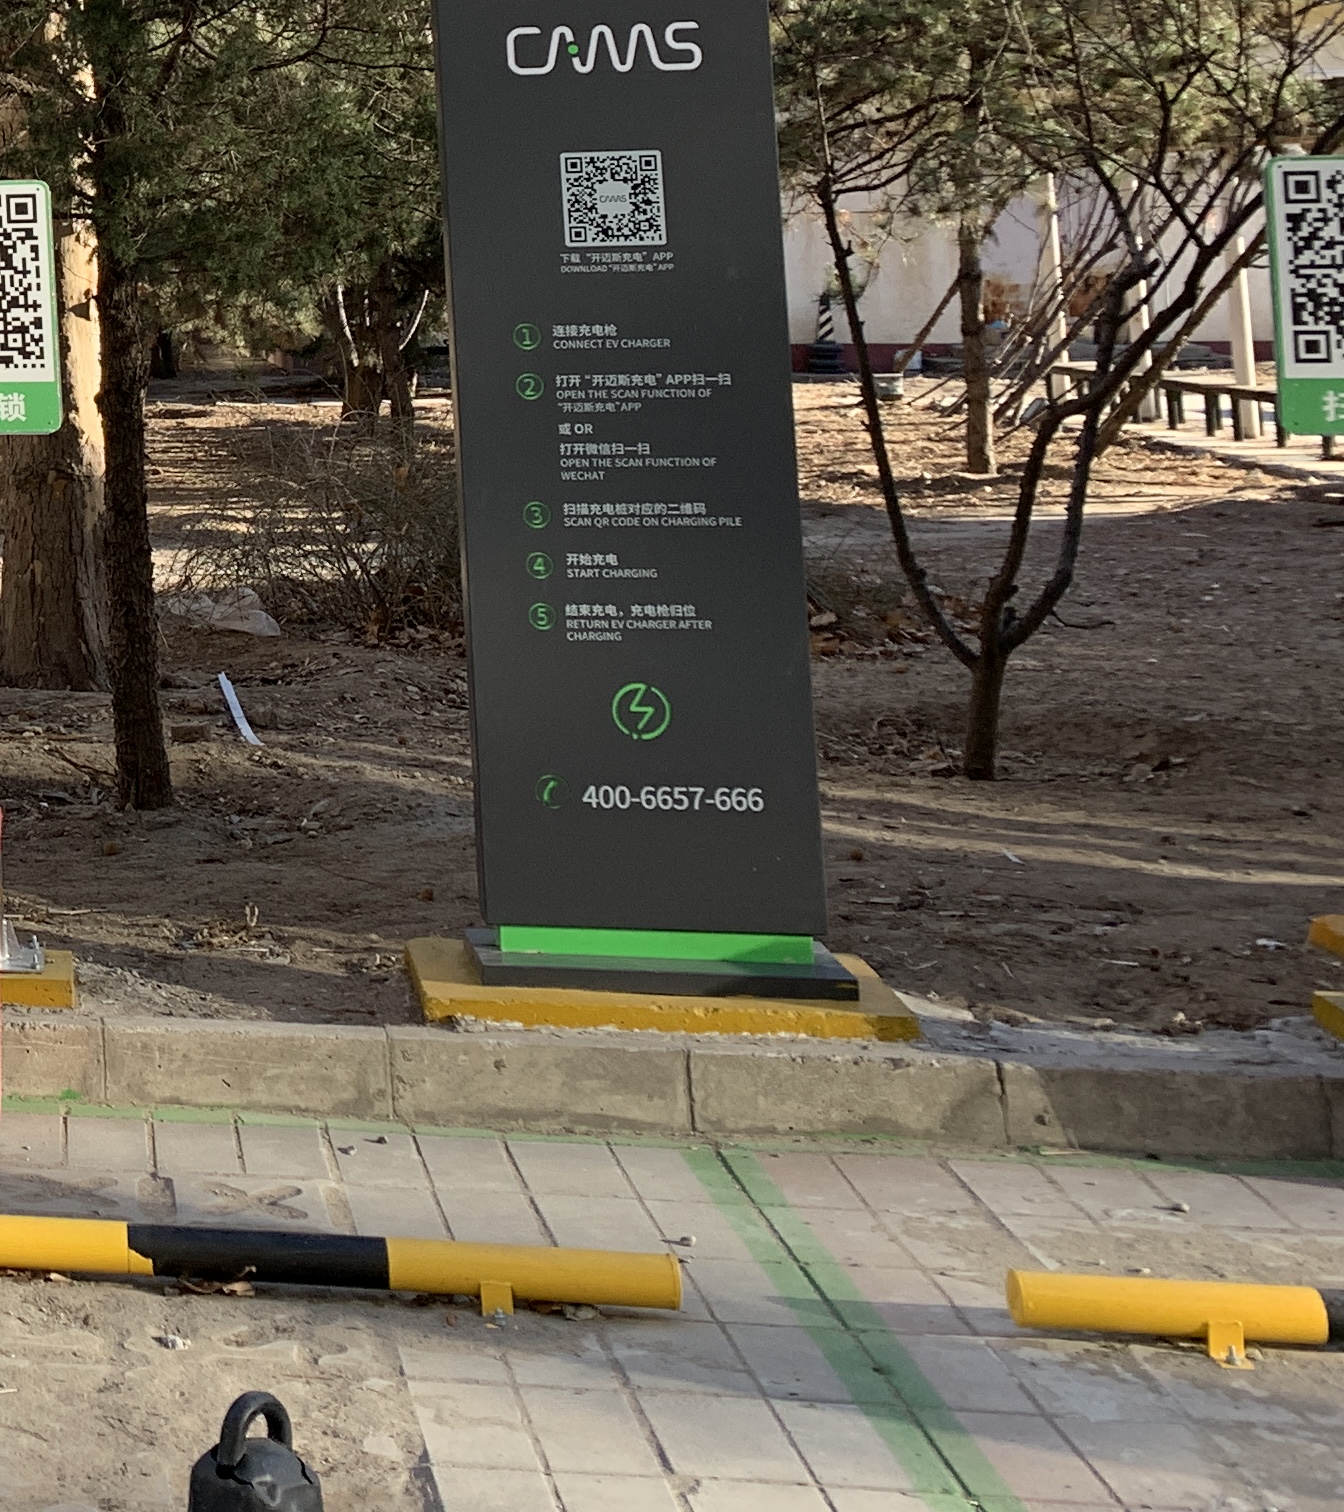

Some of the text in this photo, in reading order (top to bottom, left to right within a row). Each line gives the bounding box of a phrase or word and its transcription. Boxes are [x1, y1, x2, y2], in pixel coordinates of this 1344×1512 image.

[552, 324, 618, 338] 连接充电枪
[553, 338, 671, 350] CONNECT EV CHARGER
[556, 388, 712, 400] OPEN THE SCAN FUNCTION OF
[558, 423, 594, 436] 或 OR
[559, 442, 650, 456] 打开微信扫一扫
[560, 457, 717, 468] OPEN THE SCAN FUNCTION OF
[561, 470, 606, 481] WECHAT
[563, 502, 707, 516] 扫描充电桩对应的二维码
[563, 516, 743, 528] SCAN QR CODE ON CHARGING PILE
[566, 553, 619, 566] 开始充电
[566, 568, 658, 579] START CHARGING
[566, 619, 713, 630] RETURN EV CHARGER AFTER
[566, 631, 622, 642] CHARGING
[581, 785, 765, 812] 400-6657-666
